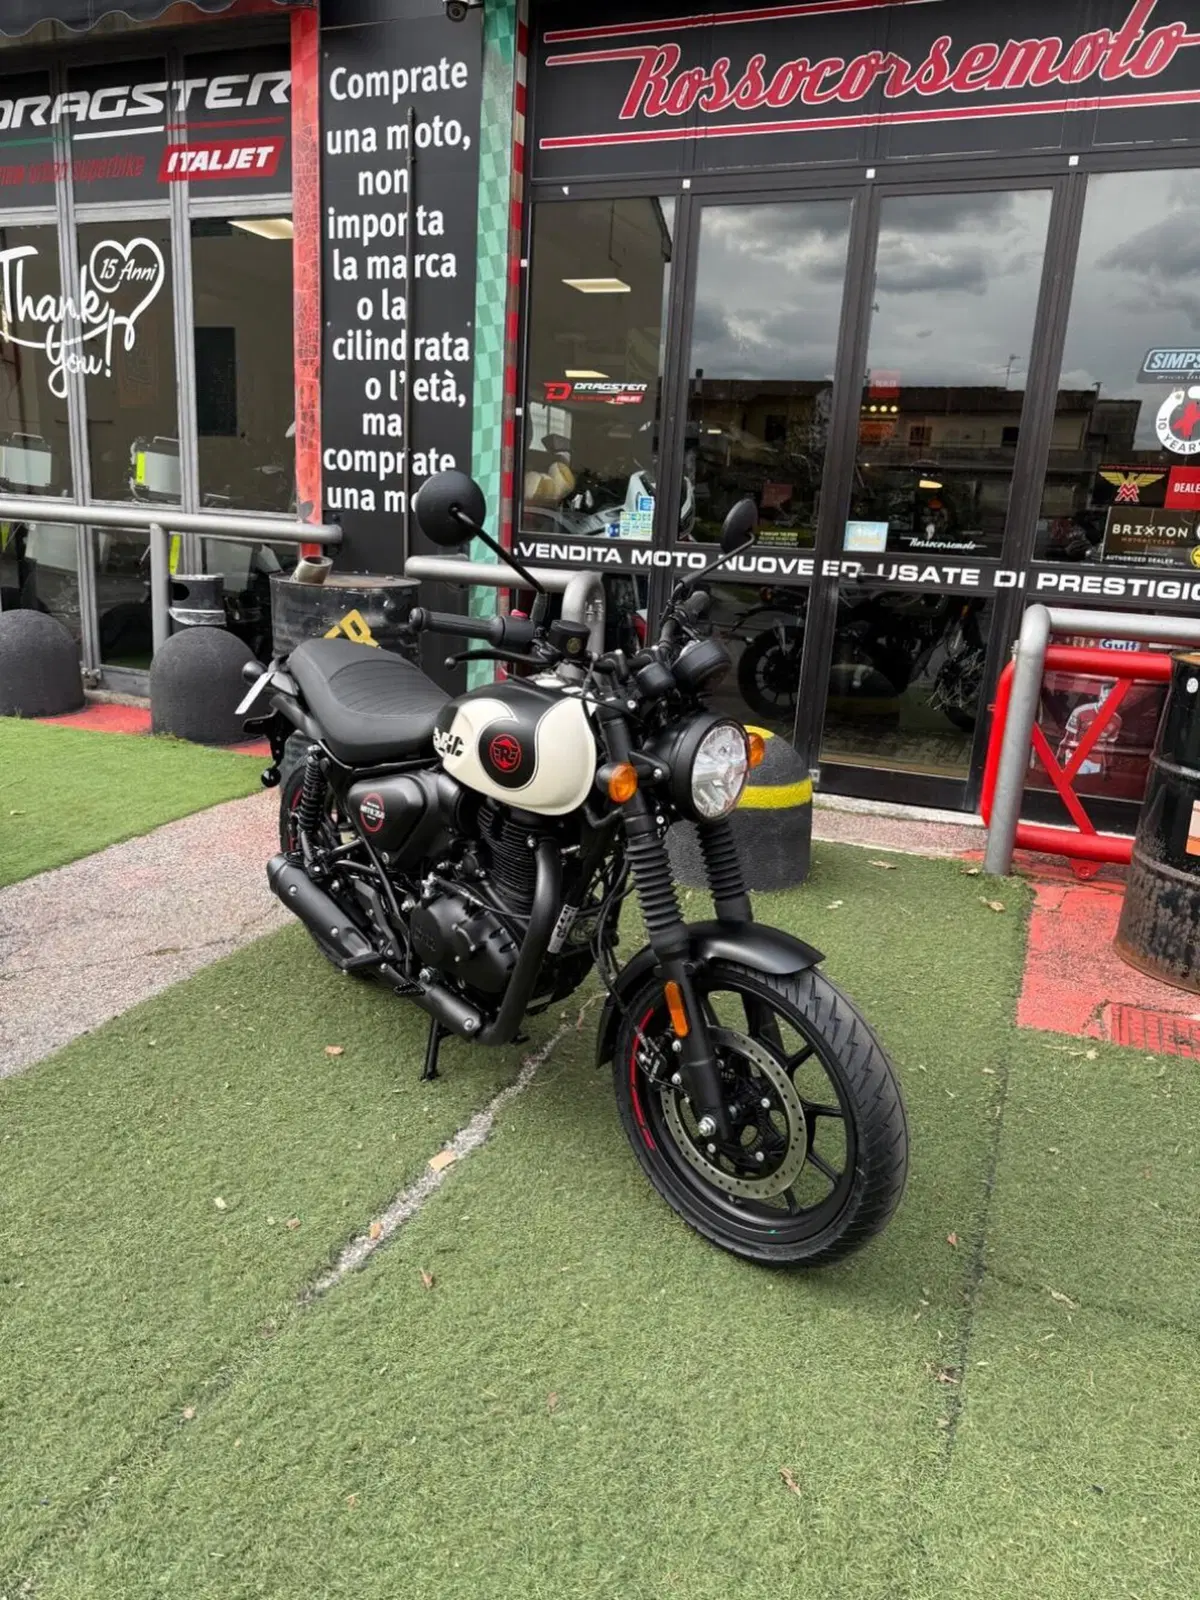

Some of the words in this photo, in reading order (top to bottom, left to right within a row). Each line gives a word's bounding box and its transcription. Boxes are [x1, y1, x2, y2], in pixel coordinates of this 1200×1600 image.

[618, 0, 1188, 120] Rossocorsemoto
[329, 57, 468, 104] Comprate
[326, 127, 377, 155] una
[386, 115, 471, 151] moto,
[167, 145, 275, 173] ITALJET
[358, 168, 408, 196] non
[328, 204, 444, 247] importa
[100, 258, 118, 280] 15
[119, 259, 158, 281] Anni
[333, 248, 358, 281] la
[366, 252, 457, 280] marca
[0, 245, 110, 324] Thank
[356, 296, 374, 321] o
[381, 287, 407, 321] la
[332, 328, 470, 362] cilindrata
[364, 377, 382, 400] o
[574, 382, 648, 392] DRAGSTER
[362, 412, 403, 437] ma
[1163, 432, 1200, 453] YEAR
[323, 447, 456, 481] comprate
[327, 486, 376, 511] una
[1111, 523, 1188, 539] BRIXTON
[519, 542, 623, 564] VENDITA
[631, 549, 708, 569] MOTO
[717, 554, 815, 576] NUOVE
[993, 569, 1026, 588] DI
